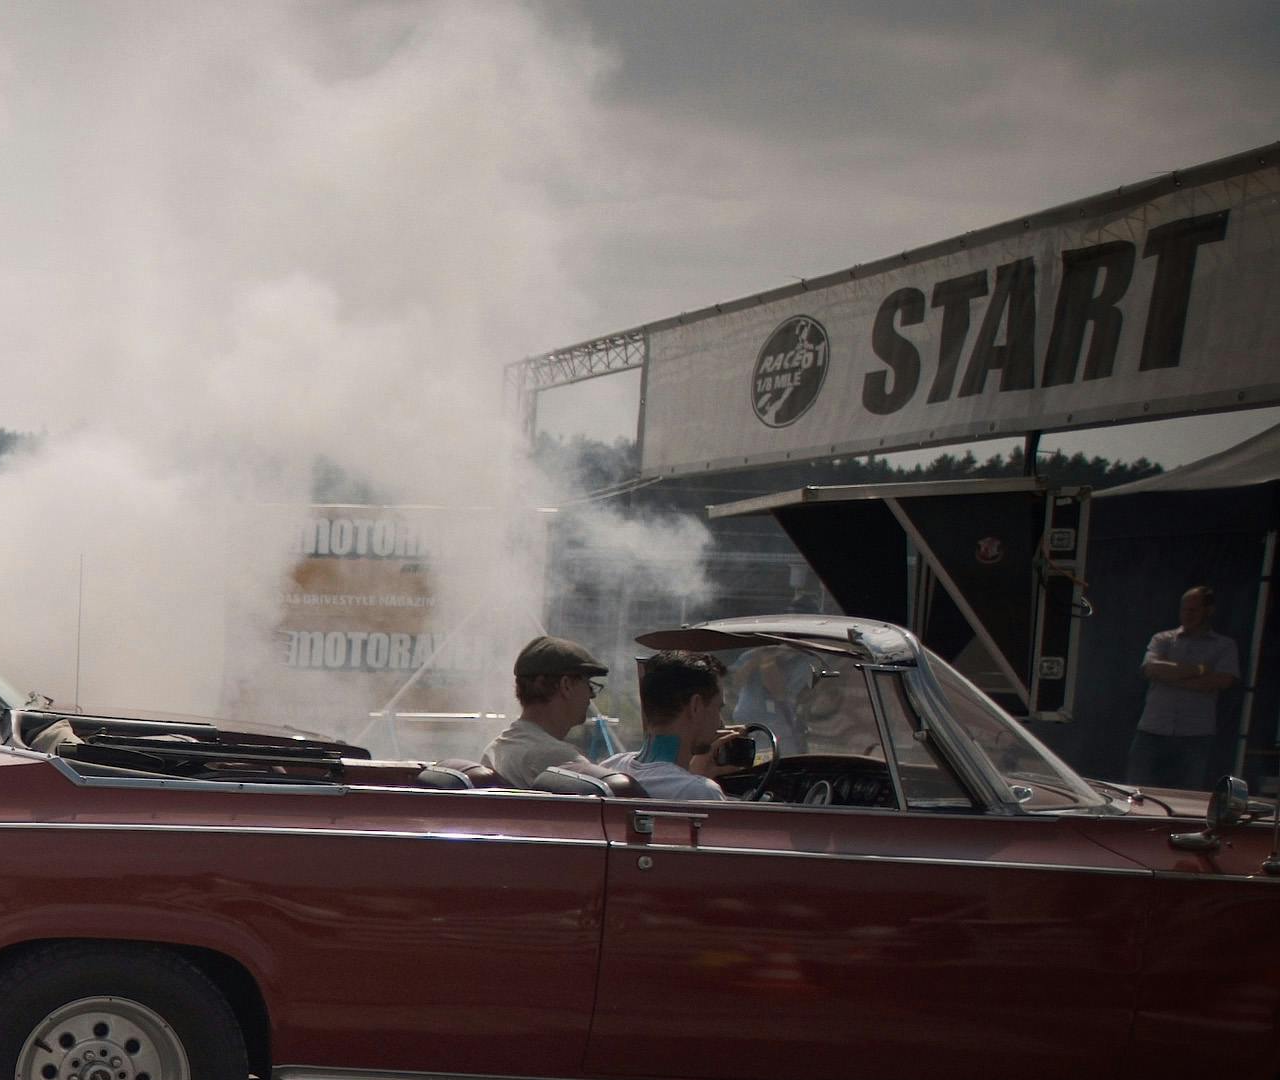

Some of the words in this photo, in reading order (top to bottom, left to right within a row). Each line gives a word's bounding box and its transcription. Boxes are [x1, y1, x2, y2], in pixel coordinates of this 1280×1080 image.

[861, 208, 1230, 415] START
[759, 350, 802, 374] RACE
[757, 377, 773, 393] 1/8
[774, 371, 801, 390] MILE
